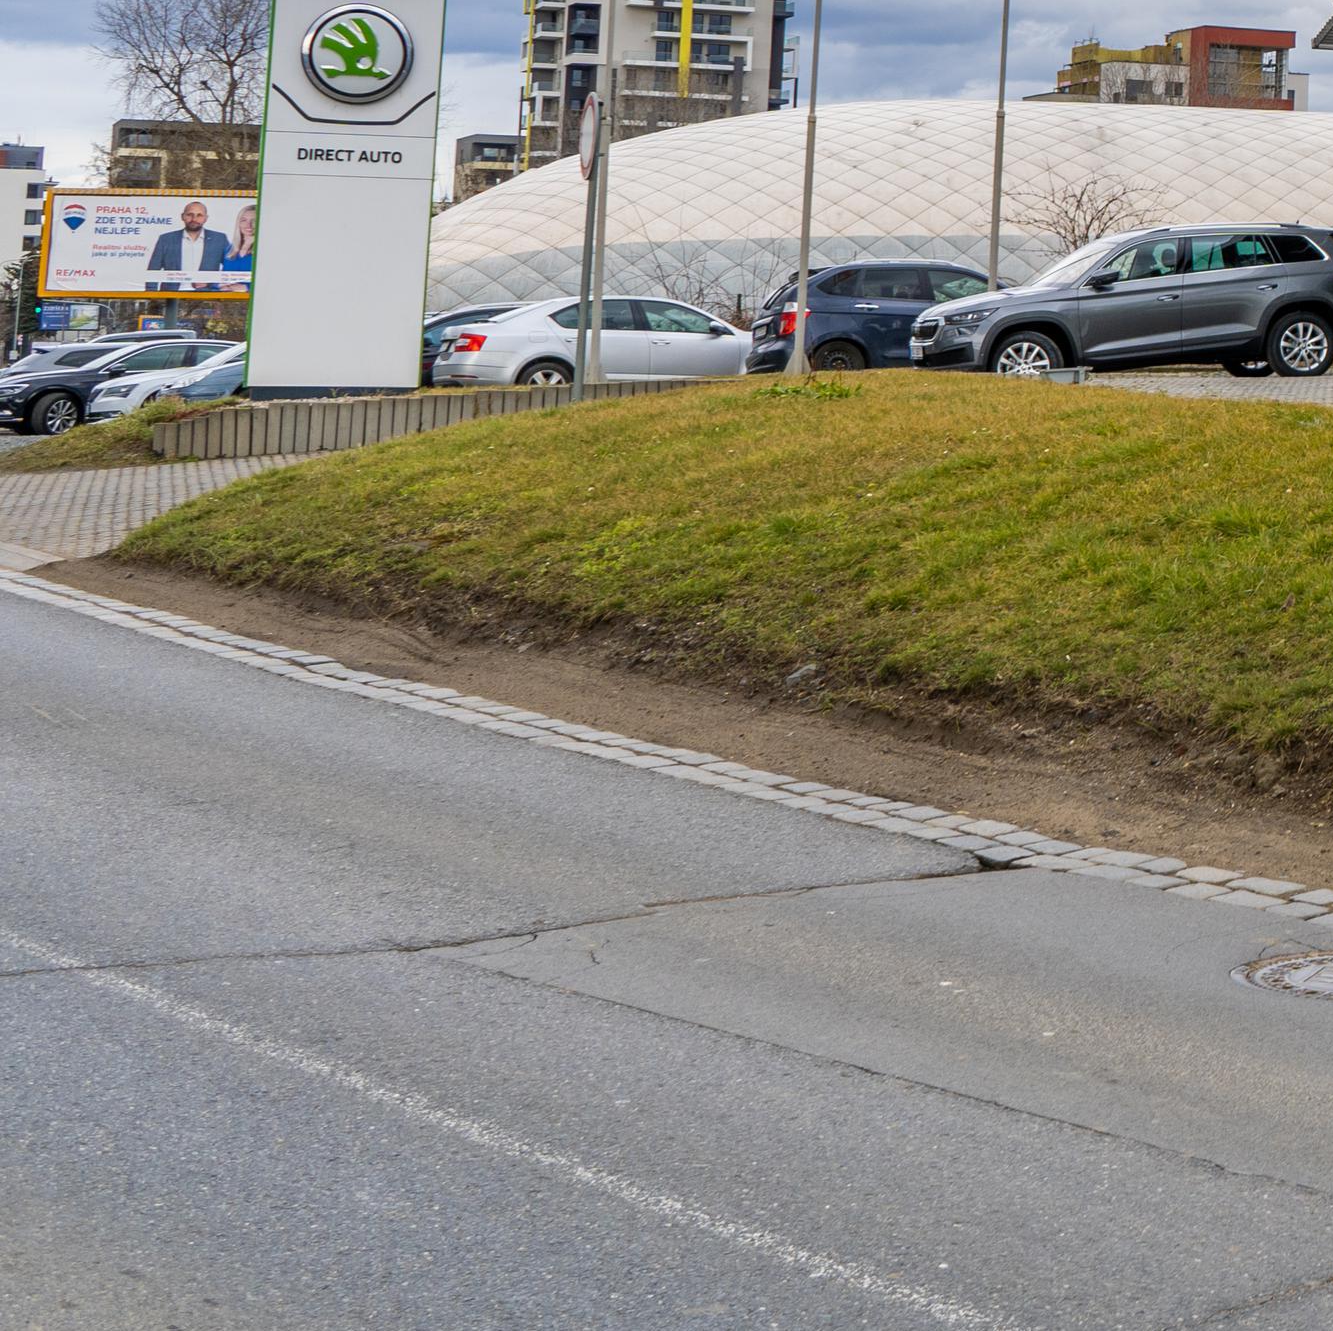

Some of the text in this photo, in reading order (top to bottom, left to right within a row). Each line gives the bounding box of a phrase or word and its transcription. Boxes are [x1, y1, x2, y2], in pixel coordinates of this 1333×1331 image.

[297, 148, 402, 164] DIRECT AUTO
[96, 205, 132, 214] PRAHA
[95, 215, 173, 225] ZDE TO ZNÁME
[56, 269, 96, 277] RE/MAX
